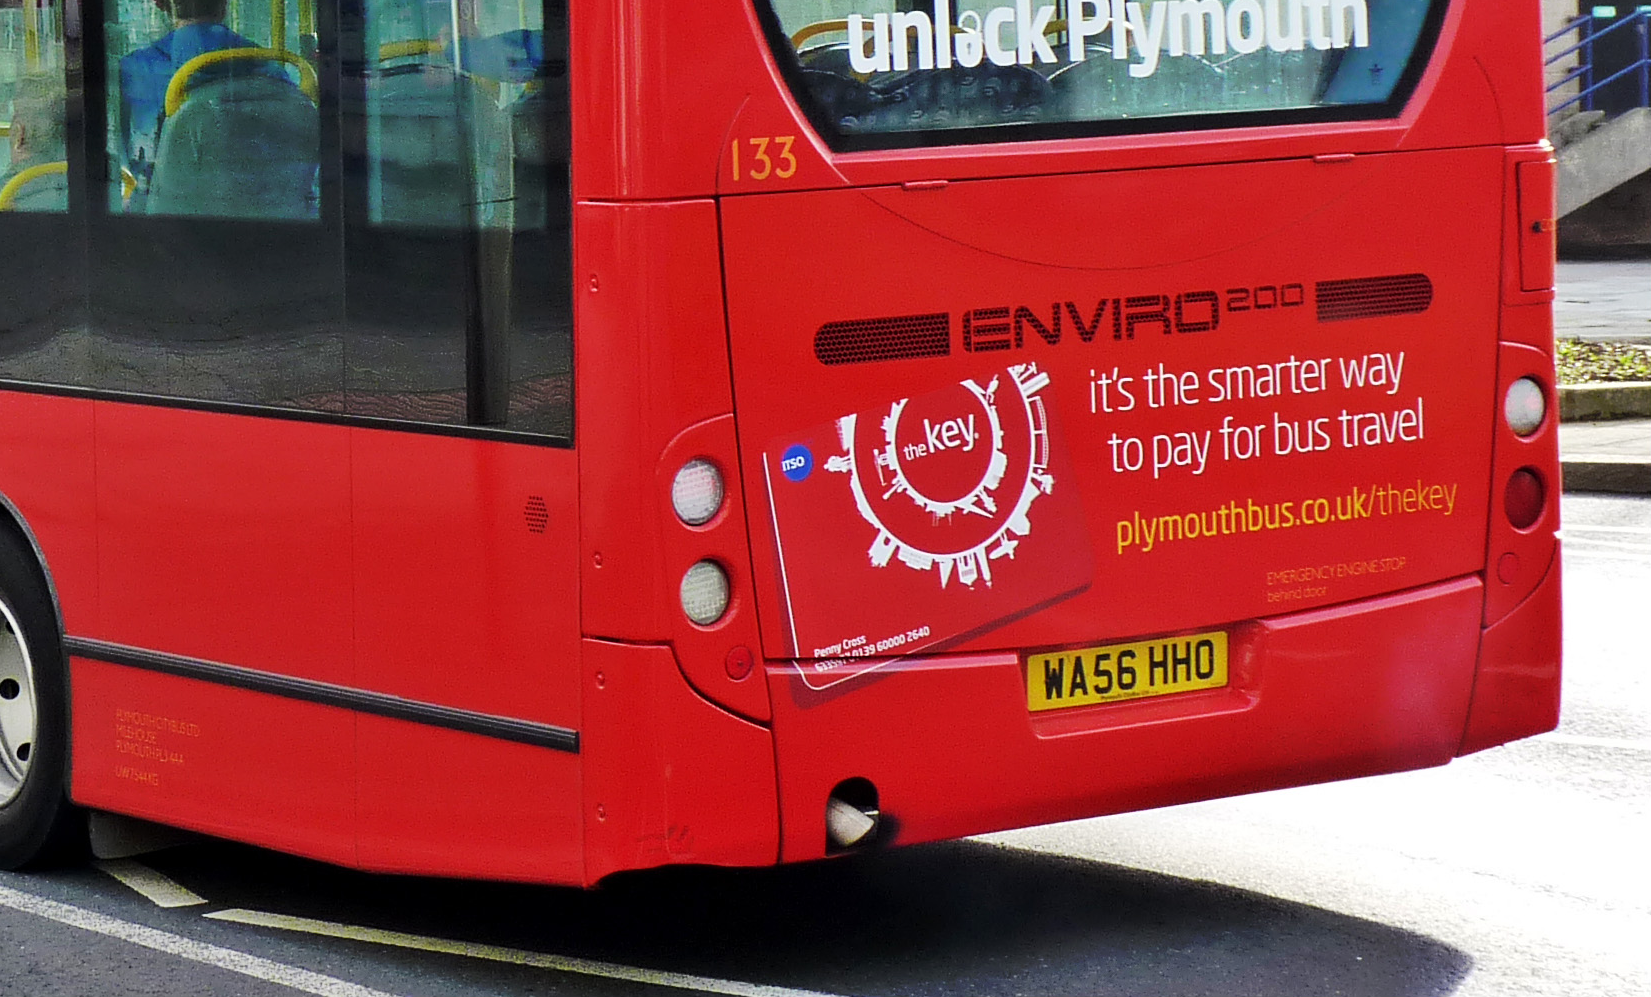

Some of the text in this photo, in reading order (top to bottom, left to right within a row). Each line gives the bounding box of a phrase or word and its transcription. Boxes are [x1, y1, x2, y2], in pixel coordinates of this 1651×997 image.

[732, 135, 797, 181] 133
[1089, 351, 1405, 414] it's the smarter way
[903, 442, 928, 461] the
[1107, 397, 1425, 479] to pay for bus travel
[781, 455, 806, 472] ITSO
[1116, 480, 1458, 554] plymouthbus.co.uk/thekey
[1266, 556, 1407, 586] EMERGENCY ENGINE STOP
[1267, 586, 1326, 603] behind door
[814, 635, 867, 658] Penny Cross
[877, 634, 906, 652] 60000
[907, 626, 930, 642] 2640
[1044, 639, 1214, 701] WA56 HHO
